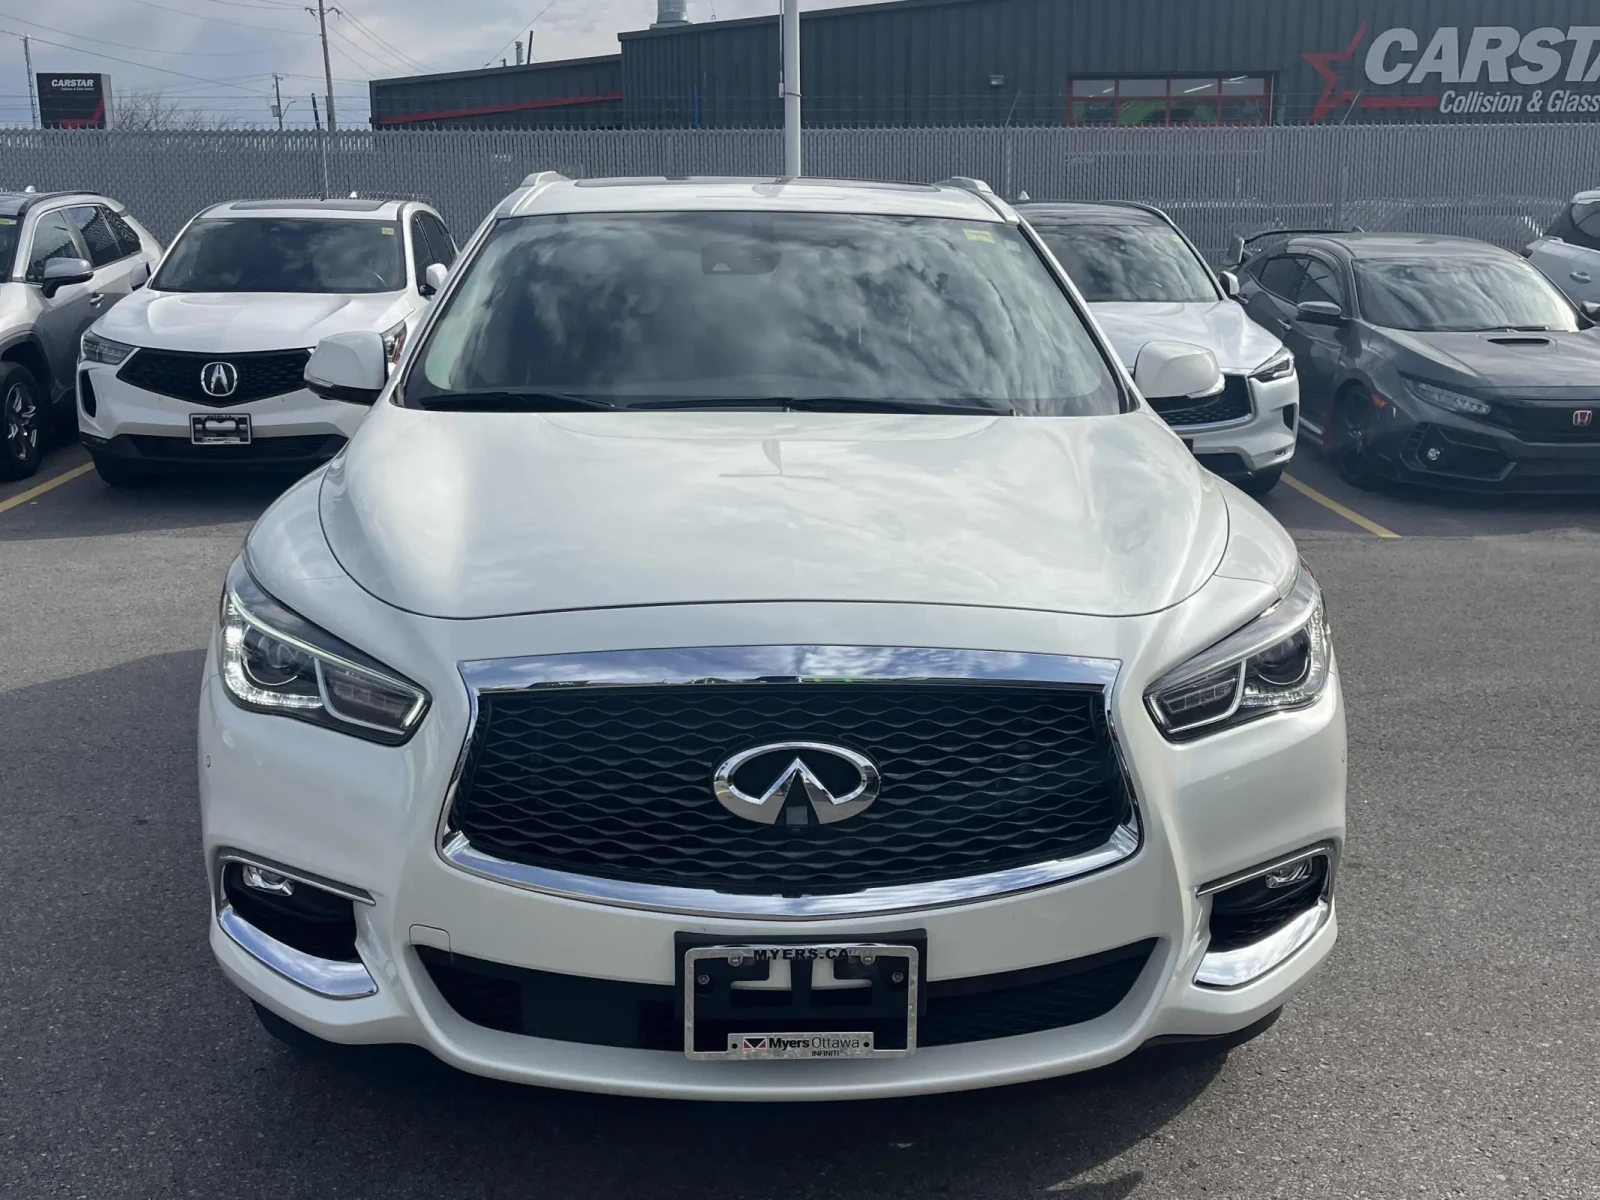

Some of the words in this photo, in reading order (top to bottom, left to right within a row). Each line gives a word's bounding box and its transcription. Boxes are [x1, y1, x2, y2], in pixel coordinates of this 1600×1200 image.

[51, 79, 94, 87] CARSTAR
[1440, 90, 1523, 113] Collision
[1526, 89, 1543, 112] &
[1547, 89, 1600, 113] Glass
[753, 948, 849, 960] MYERS.CA
[768, 1037, 810, 1051] Myers
[811, 1036, 860, 1049] Ottawa
